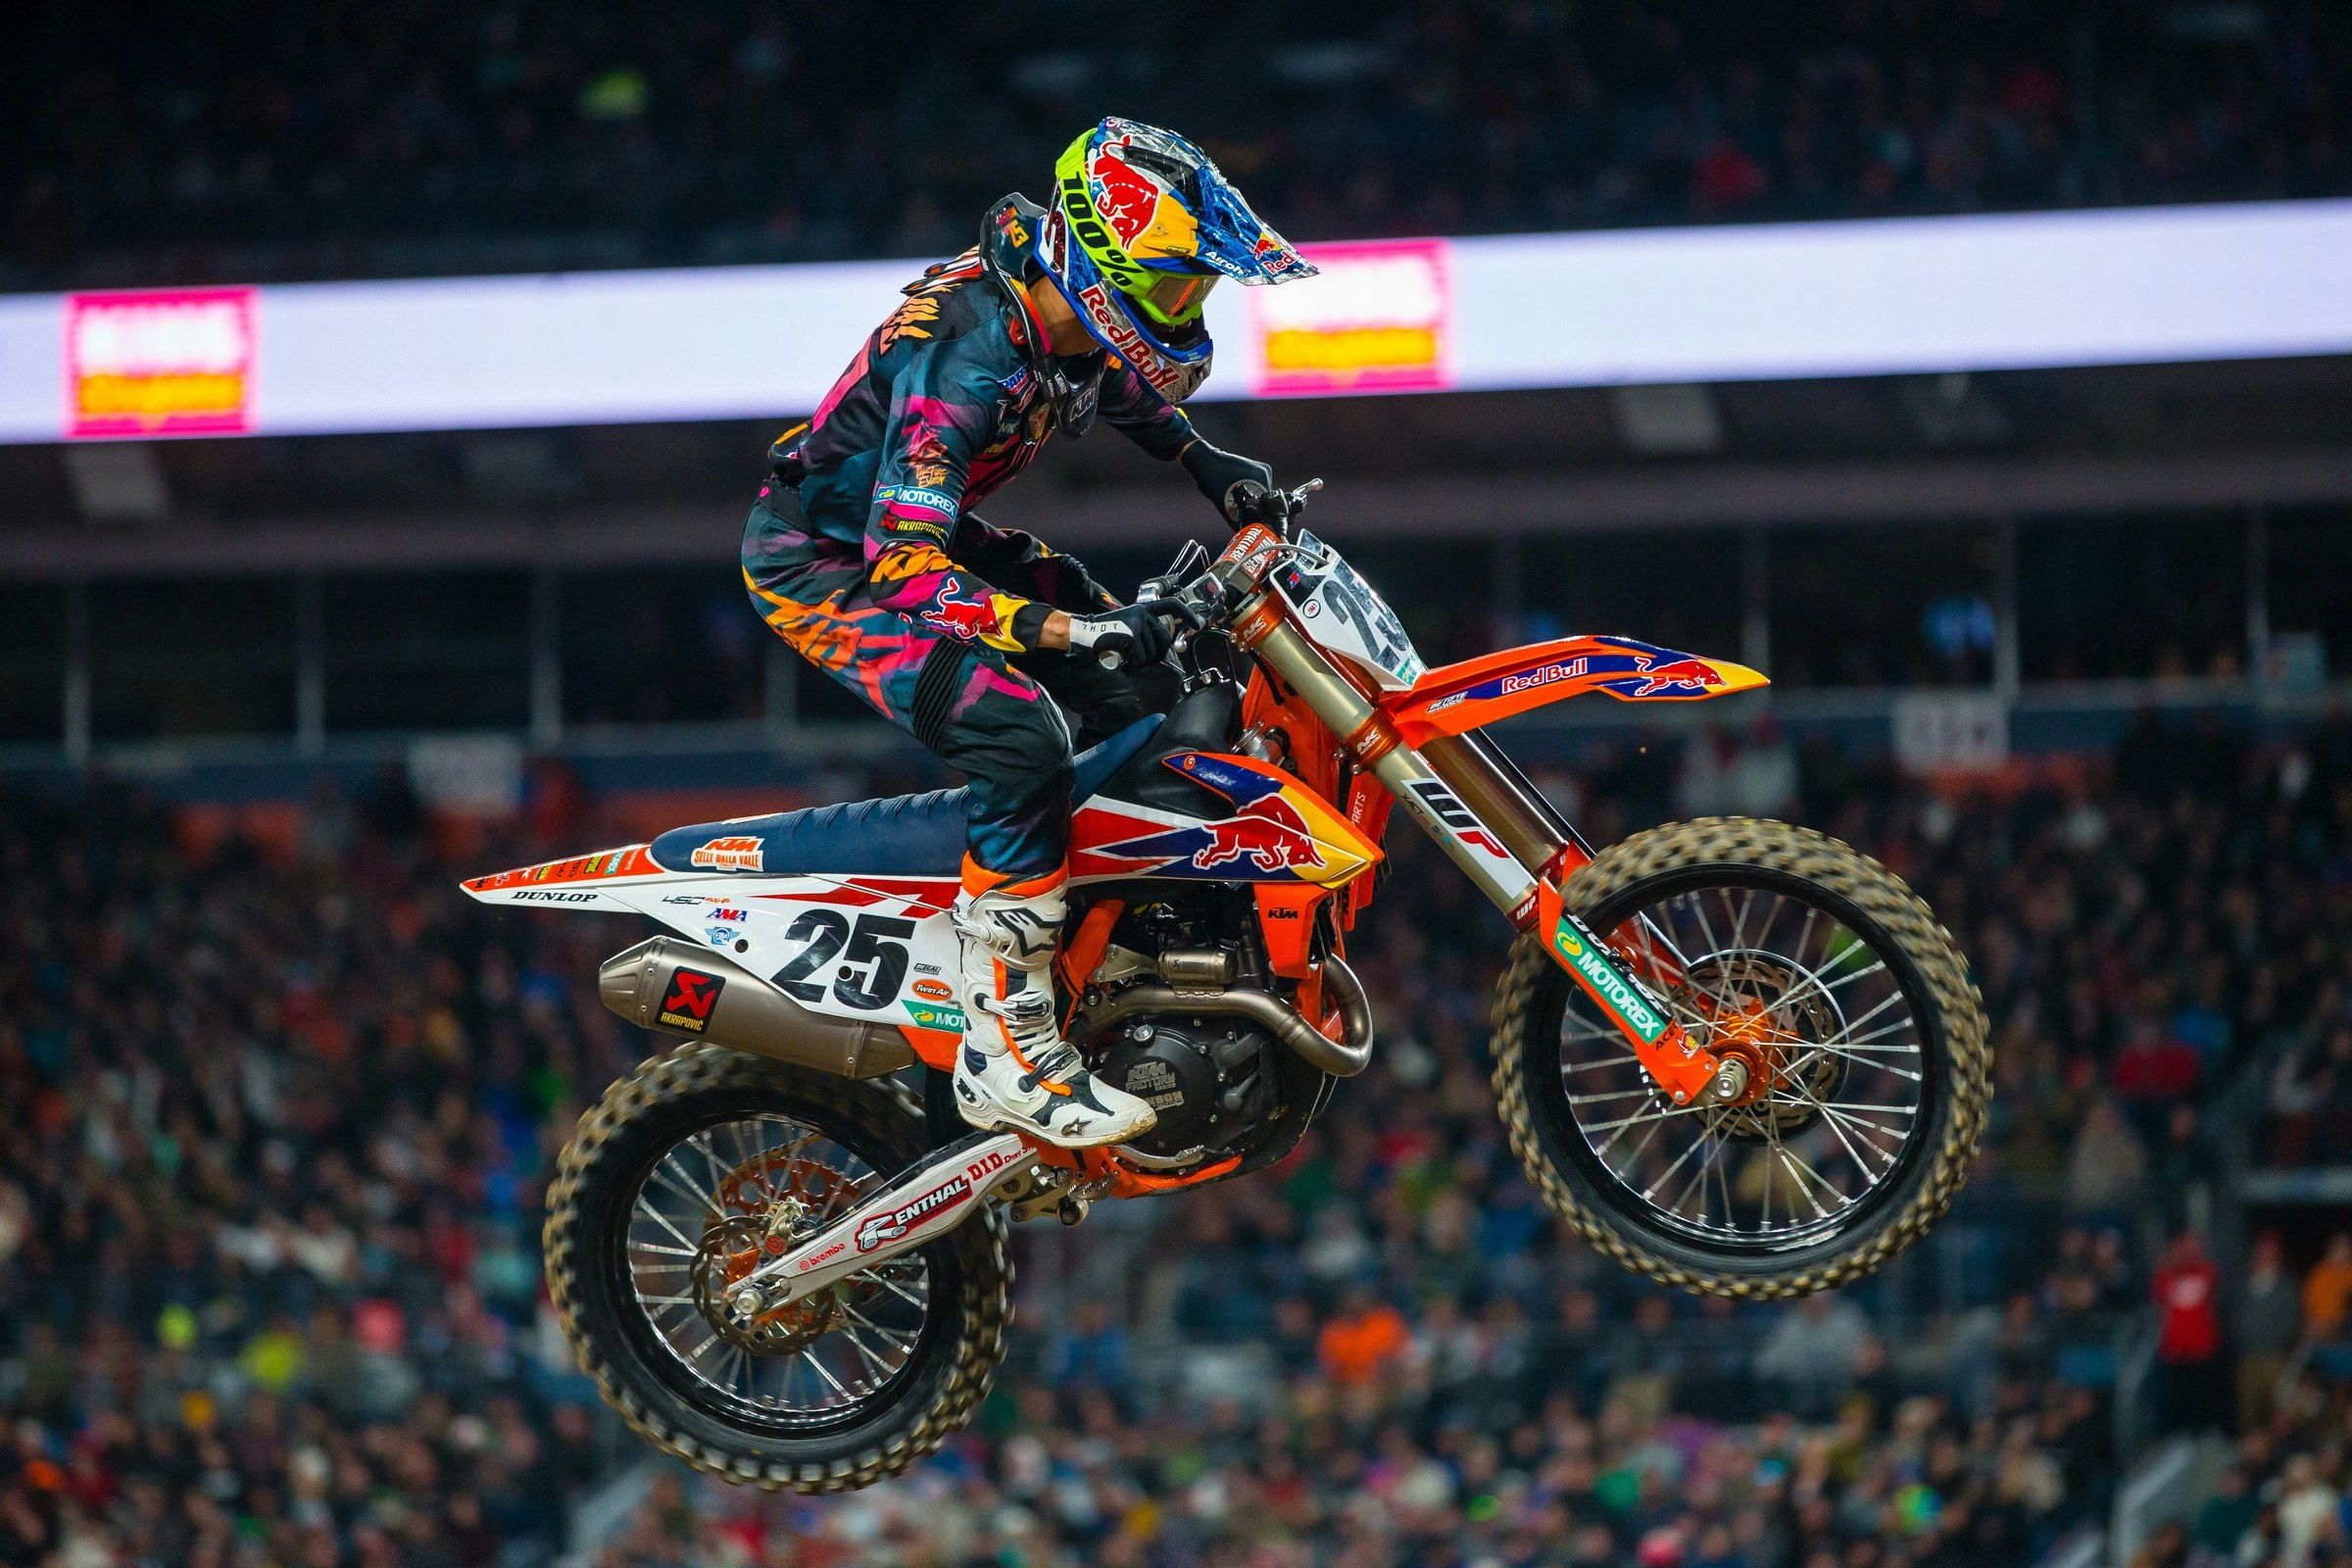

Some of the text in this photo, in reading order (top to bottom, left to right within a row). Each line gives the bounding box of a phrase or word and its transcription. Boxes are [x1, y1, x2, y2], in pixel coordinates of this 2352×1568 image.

[1004, 220, 1030, 248] 25
[1063, 172, 1146, 286] 100%
[1205, 251, 1244, 274] Airoh
[1263, 251, 1297, 274] Red
[1080, 286, 1181, 390] Red Bull
[897, 488, 955, 515] MOTOREX
[1230, 528, 1262, 561] RENTHAL
[1323, 560, 1409, 671] 25
[1502, 658, 1588, 694] Red Bull
[705, 838, 760, 852] KTM
[695, 851, 760, 868] SELLE DALLA VALLE
[511, 891, 599, 903] DUNLOP
[662, 896, 706, 905] 450
[707, 907, 748, 922] AMA
[1268, 906, 1298, 919] KTM
[769, 908, 917, 1010] 25
[915, 984, 951, 997] Twin Air
[1577, 951, 1661, 1039] MOTOREX
[1125, 1072, 1176, 1093] FACTORY
[1128, 1061, 1166, 1082] KTM
[1144, 1090, 1183, 1107] NSON
[1004, 1152, 1021, 1164] DIRT
[858, 1179, 968, 1250] RENTHAL
[808, 1243, 845, 1266] brembo
